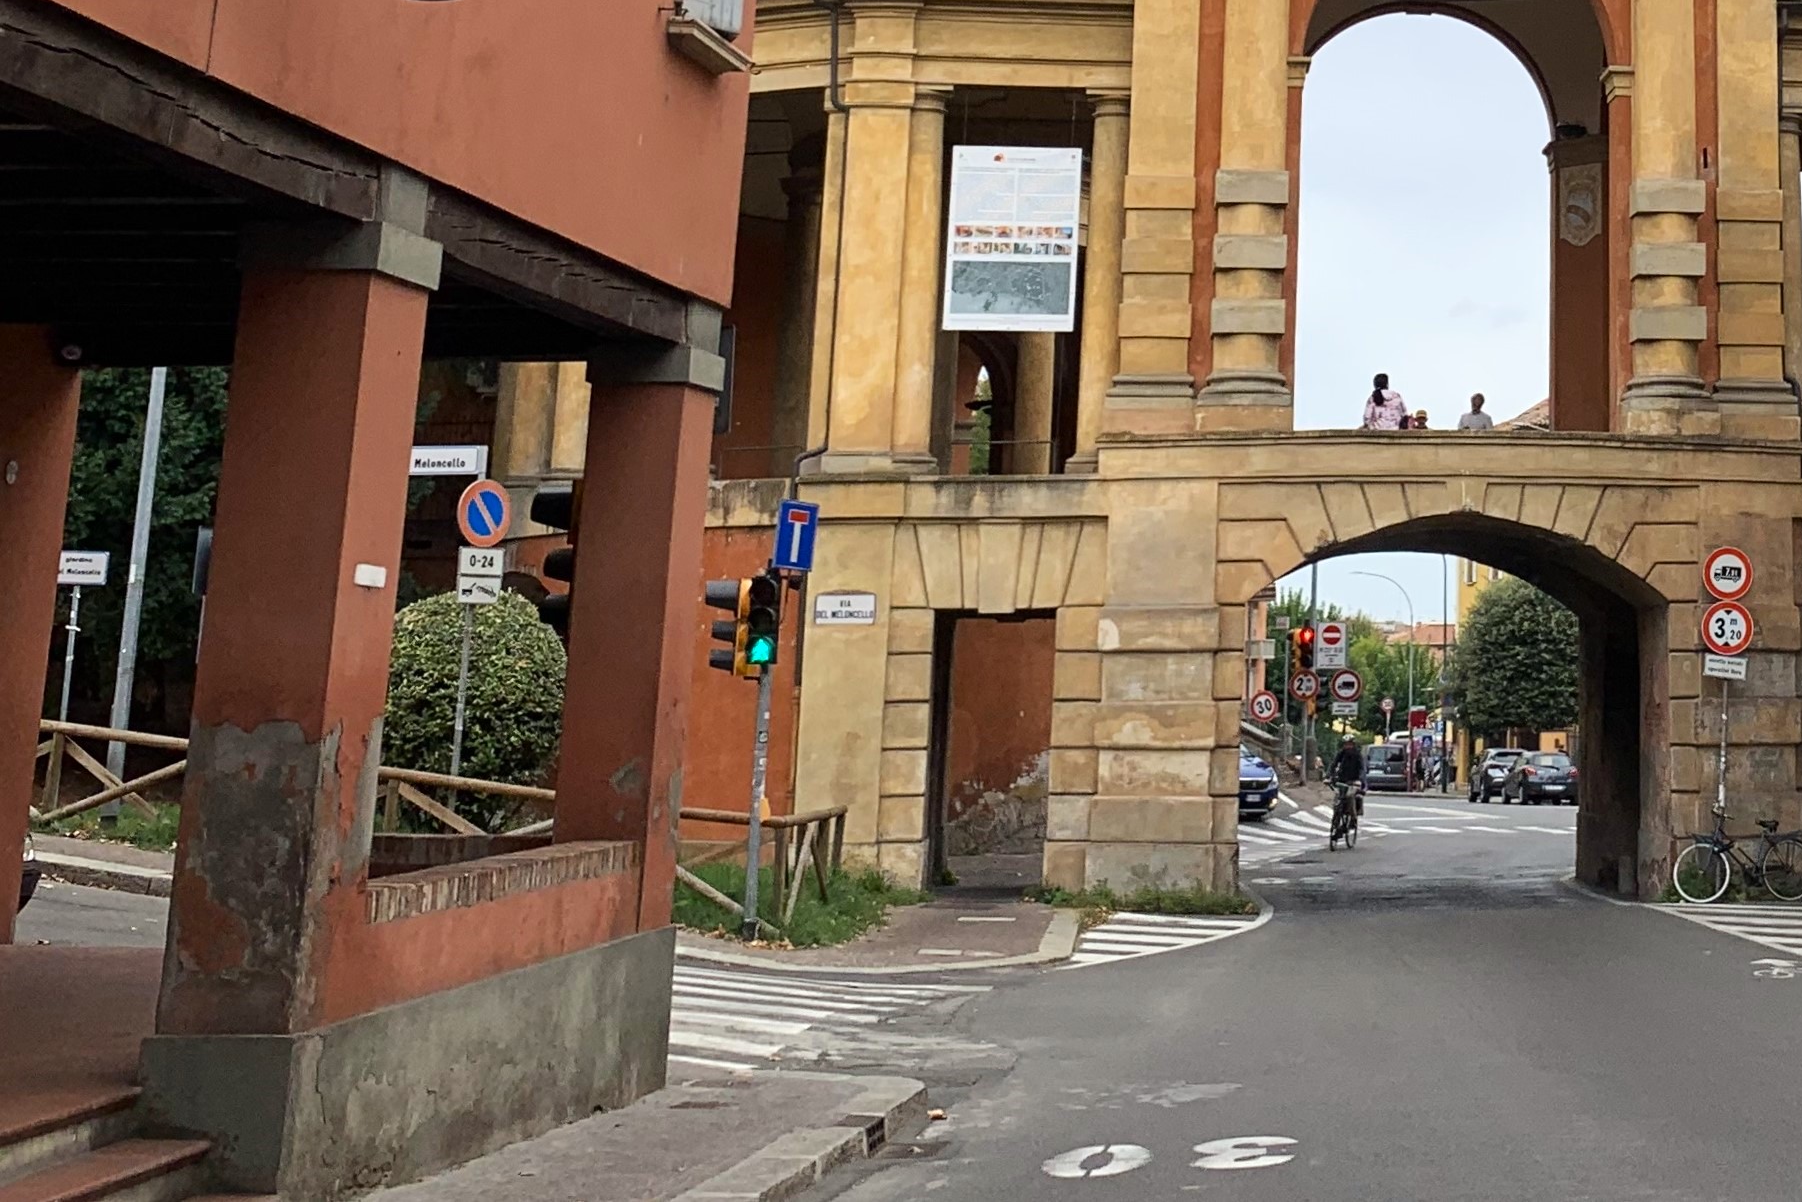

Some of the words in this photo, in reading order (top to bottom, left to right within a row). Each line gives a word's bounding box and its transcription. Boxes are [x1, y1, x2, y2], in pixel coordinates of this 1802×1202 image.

[414, 458, 466, 469] Meloncello
[469, 555, 494, 568] 0-24
[1256, 698, 1272, 714] 30
